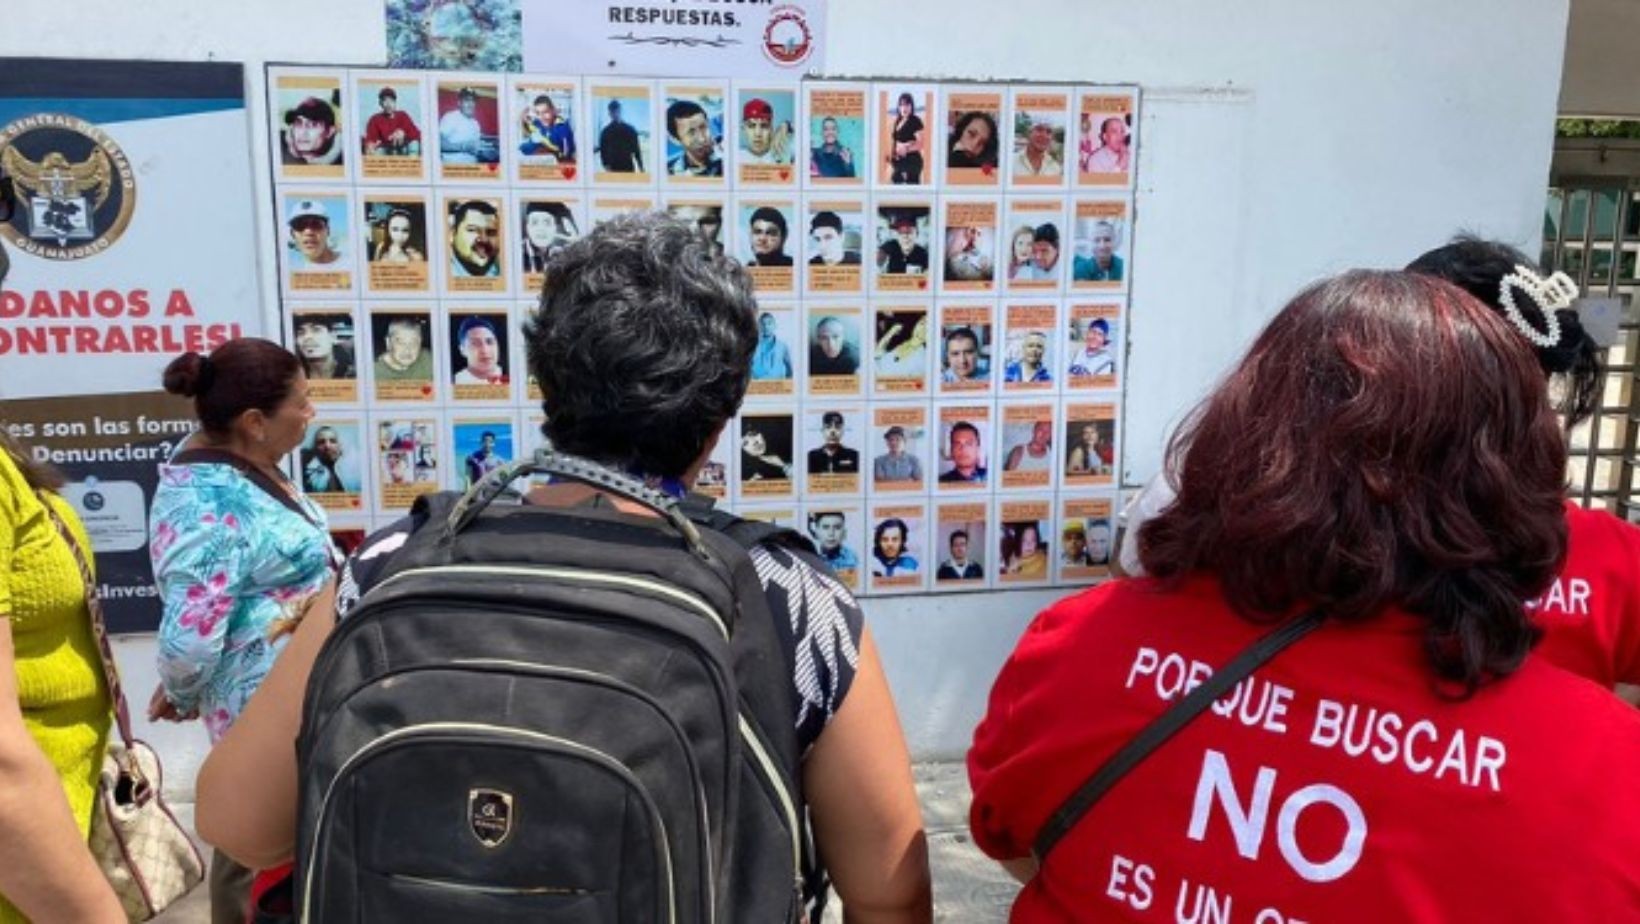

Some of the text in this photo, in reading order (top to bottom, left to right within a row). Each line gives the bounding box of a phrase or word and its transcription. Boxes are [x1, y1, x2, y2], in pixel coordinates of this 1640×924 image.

[608, 7, 741, 27] RESPUESTAS.
[164, 289, 194, 317] A
[43, 422, 86, 436] son
[94, 416, 130, 435] las
[33, 442, 172, 464] Denunciar?
[1310, 699, 1507, 792] BUSCAR
[1186, 748, 1368, 883] NO
[1106, 855, 1233, 924] ES UN
